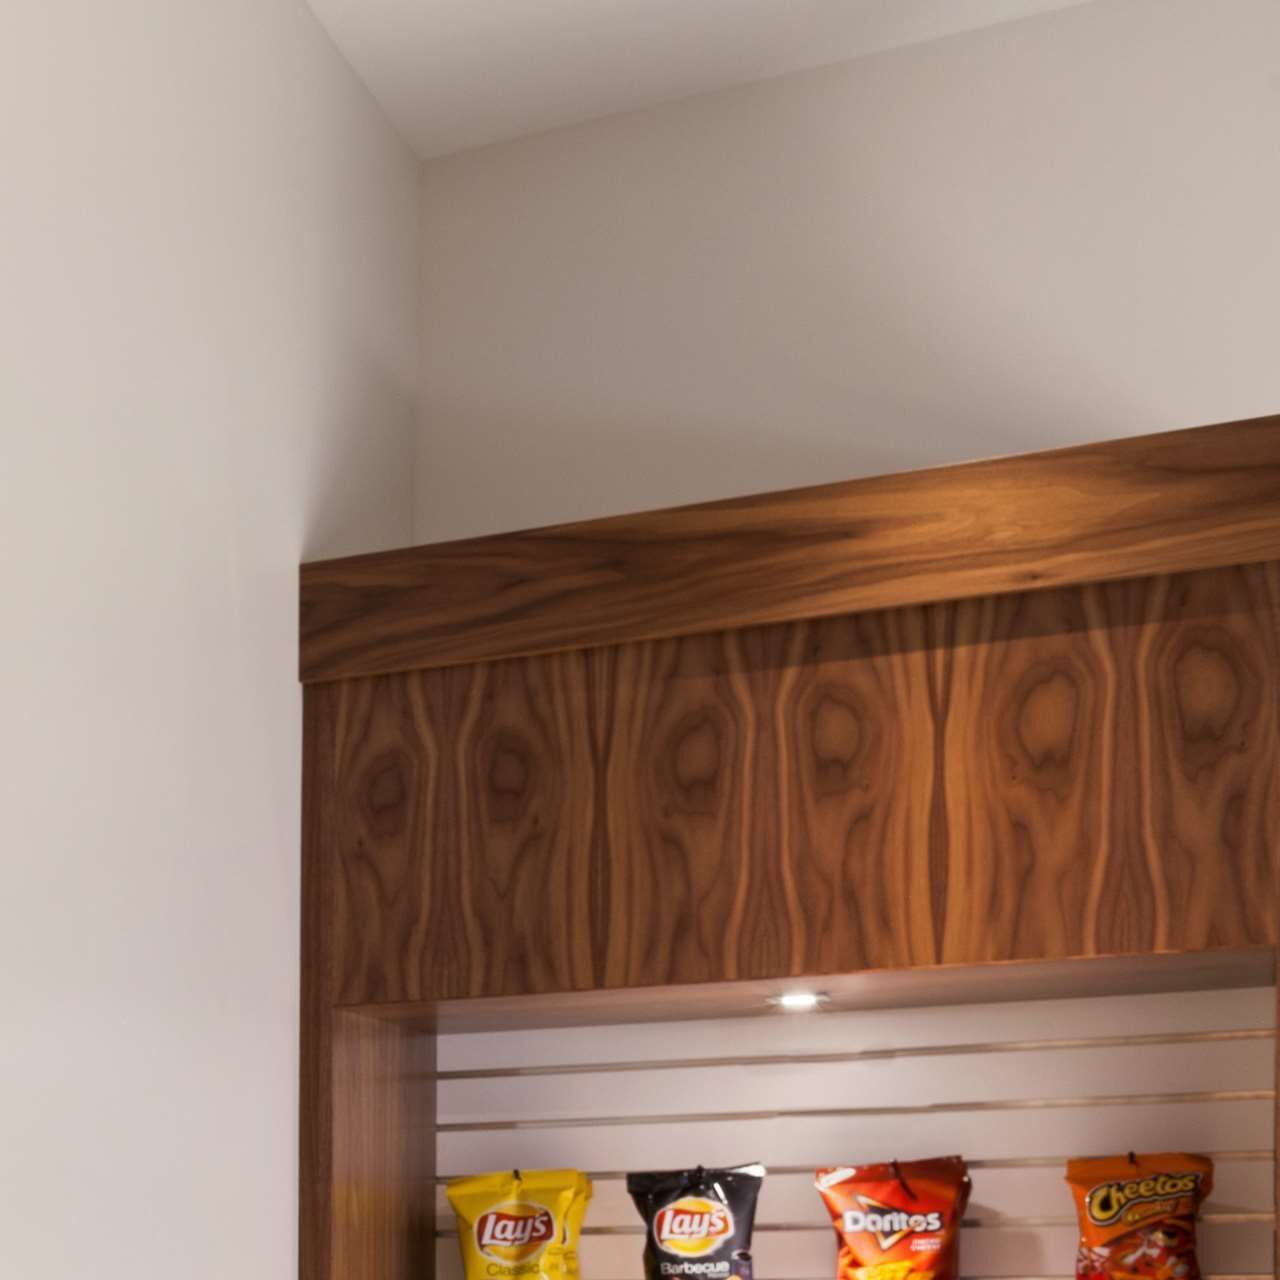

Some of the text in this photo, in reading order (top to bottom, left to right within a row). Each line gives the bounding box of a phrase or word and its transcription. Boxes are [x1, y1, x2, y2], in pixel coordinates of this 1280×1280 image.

[1088, 1173, 1198, 1221] Cheetos
[843, 1211, 942, 1232] Doritos
[660, 1261, 730, 1275] Barbecue
